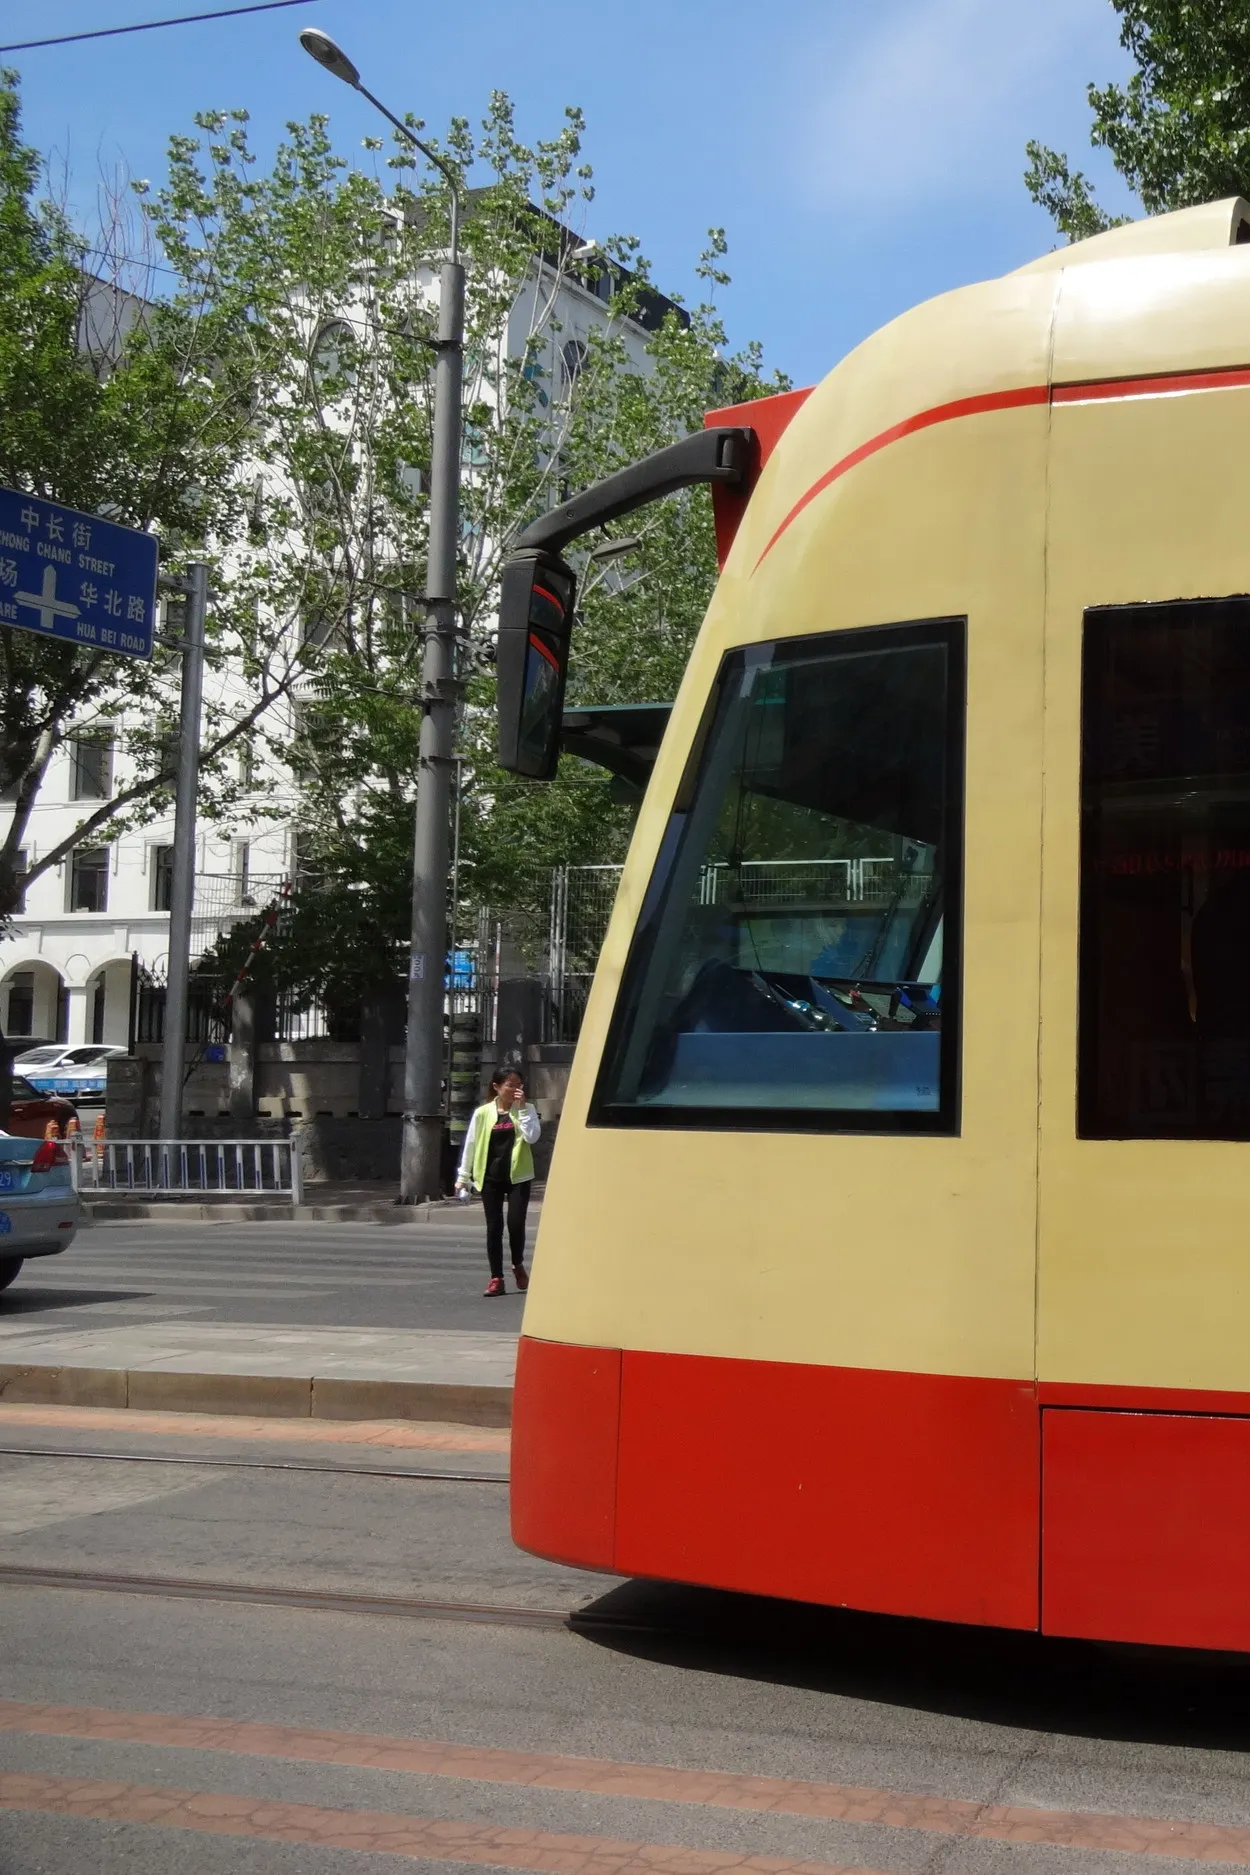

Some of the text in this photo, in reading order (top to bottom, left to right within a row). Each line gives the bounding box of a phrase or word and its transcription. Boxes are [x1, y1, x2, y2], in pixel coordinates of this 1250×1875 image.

[20, 506, 92, 551] 中长街
[37, 541, 72, 565] CHANG
[79, 554, 116, 578] STREET
[79, 581, 146, 624] 华北路
[77, 621, 146, 652] HUA BEI ROAD
